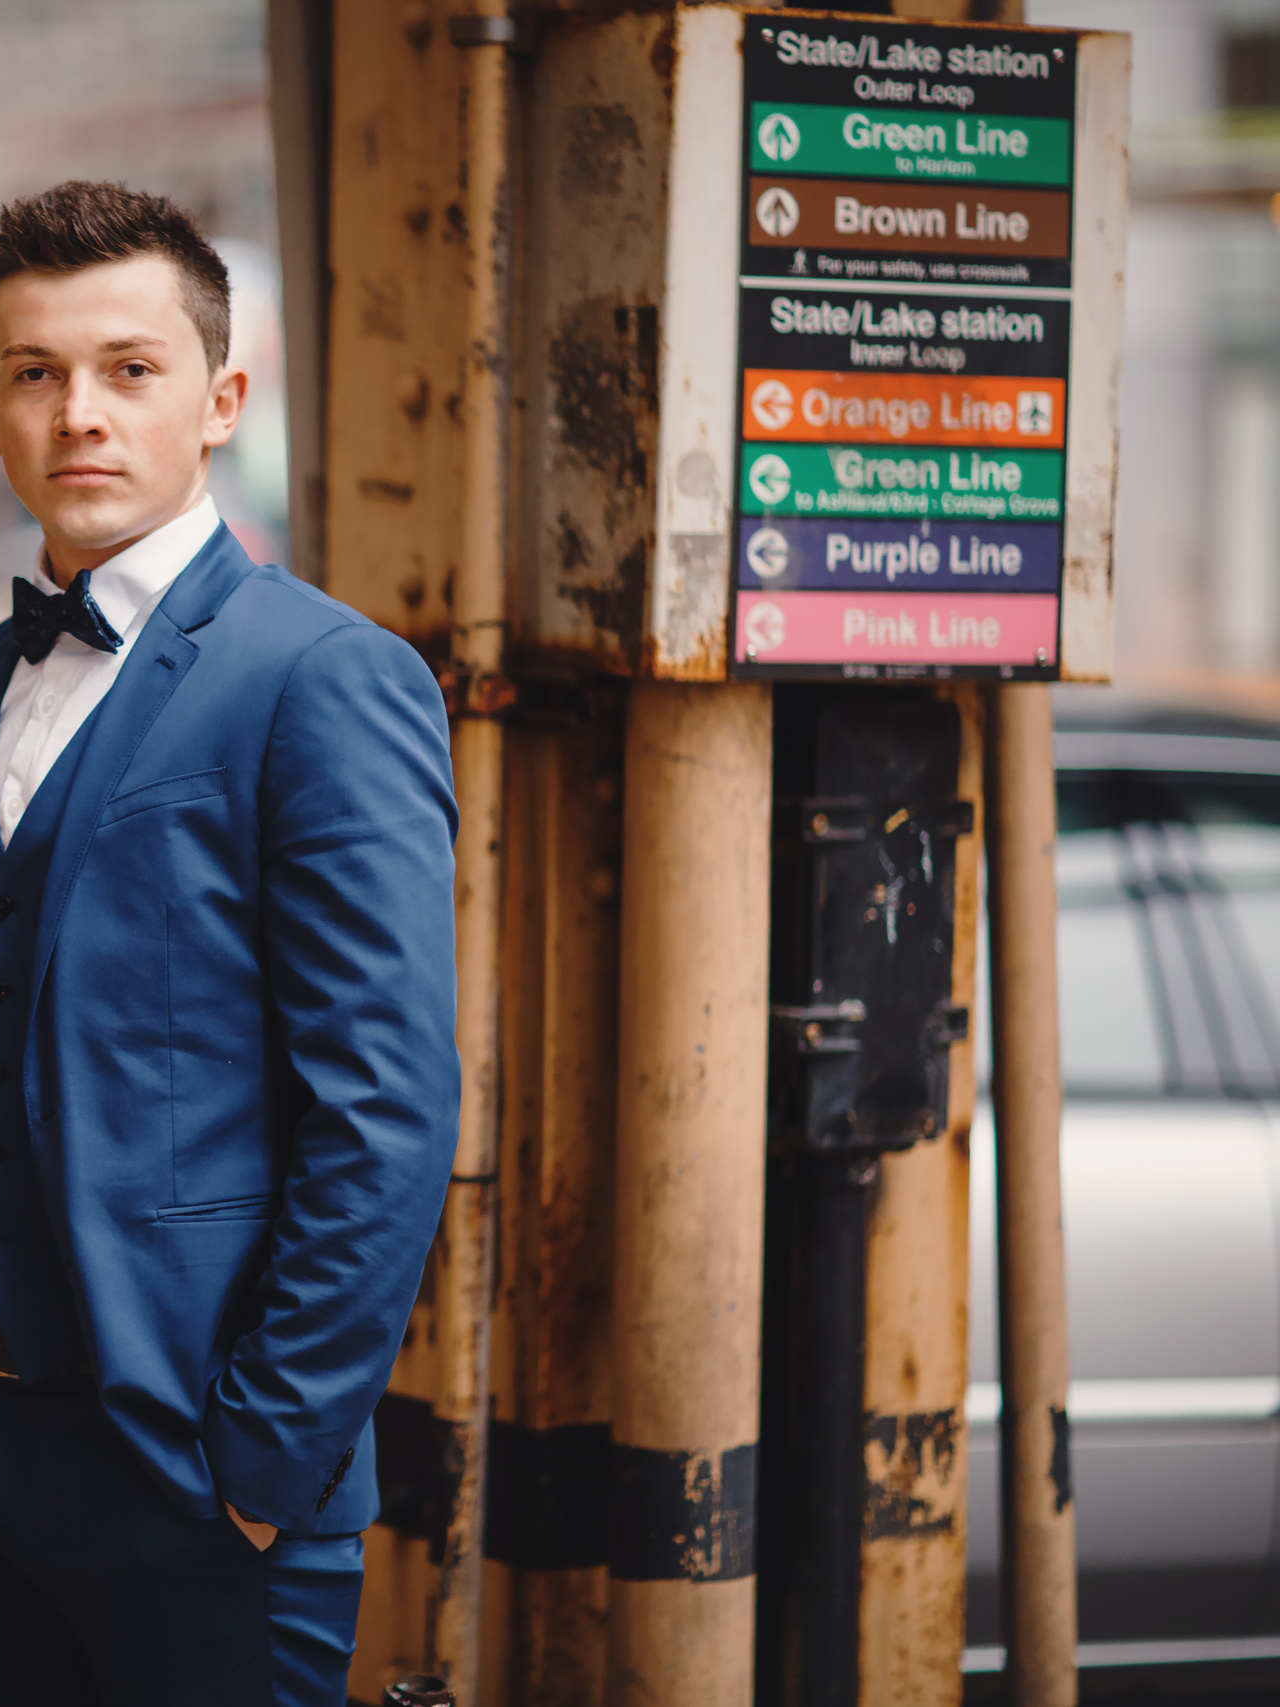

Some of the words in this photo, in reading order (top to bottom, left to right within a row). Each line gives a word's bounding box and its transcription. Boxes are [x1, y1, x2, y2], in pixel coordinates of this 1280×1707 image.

[777, 30, 942, 73] State/Lake
[947, 44, 1050, 79] station
[854, 75, 915, 102] Outer
[919, 79, 975, 109] Loop
[843, 113, 946, 153] Green
[956, 119, 1029, 157] Line
[895, 156, 913, 174] to
[917, 156, 976, 177] Harlem
[834, 196, 946, 238] Brown
[955, 203, 1030, 243] Line
[817, 255, 843, 275] For
[844, 259, 878, 279] your
[929, 262, 957, 280] use
[958, 262, 1030, 283] crosswalk
[770, 297, 936, 338] State/Lake
[941, 306, 1044, 343] station
[850, 339, 907, 367] Inner
[910, 341, 966, 373] Loop
[801, 388, 931, 438] Orange
[940, 392, 1013, 432] Line
[835, 449, 940, 489] Green
[949, 453, 1023, 492] Line
[795, 490, 814, 511] to
[941, 492, 1007, 519] Cottage
[1009, 493, 1060, 517] Grove
[826, 533, 940, 582] Purple
[949, 535, 1023, 576] Line
[842, 608, 918, 647] Pink
[928, 610, 1001, 648] Line
